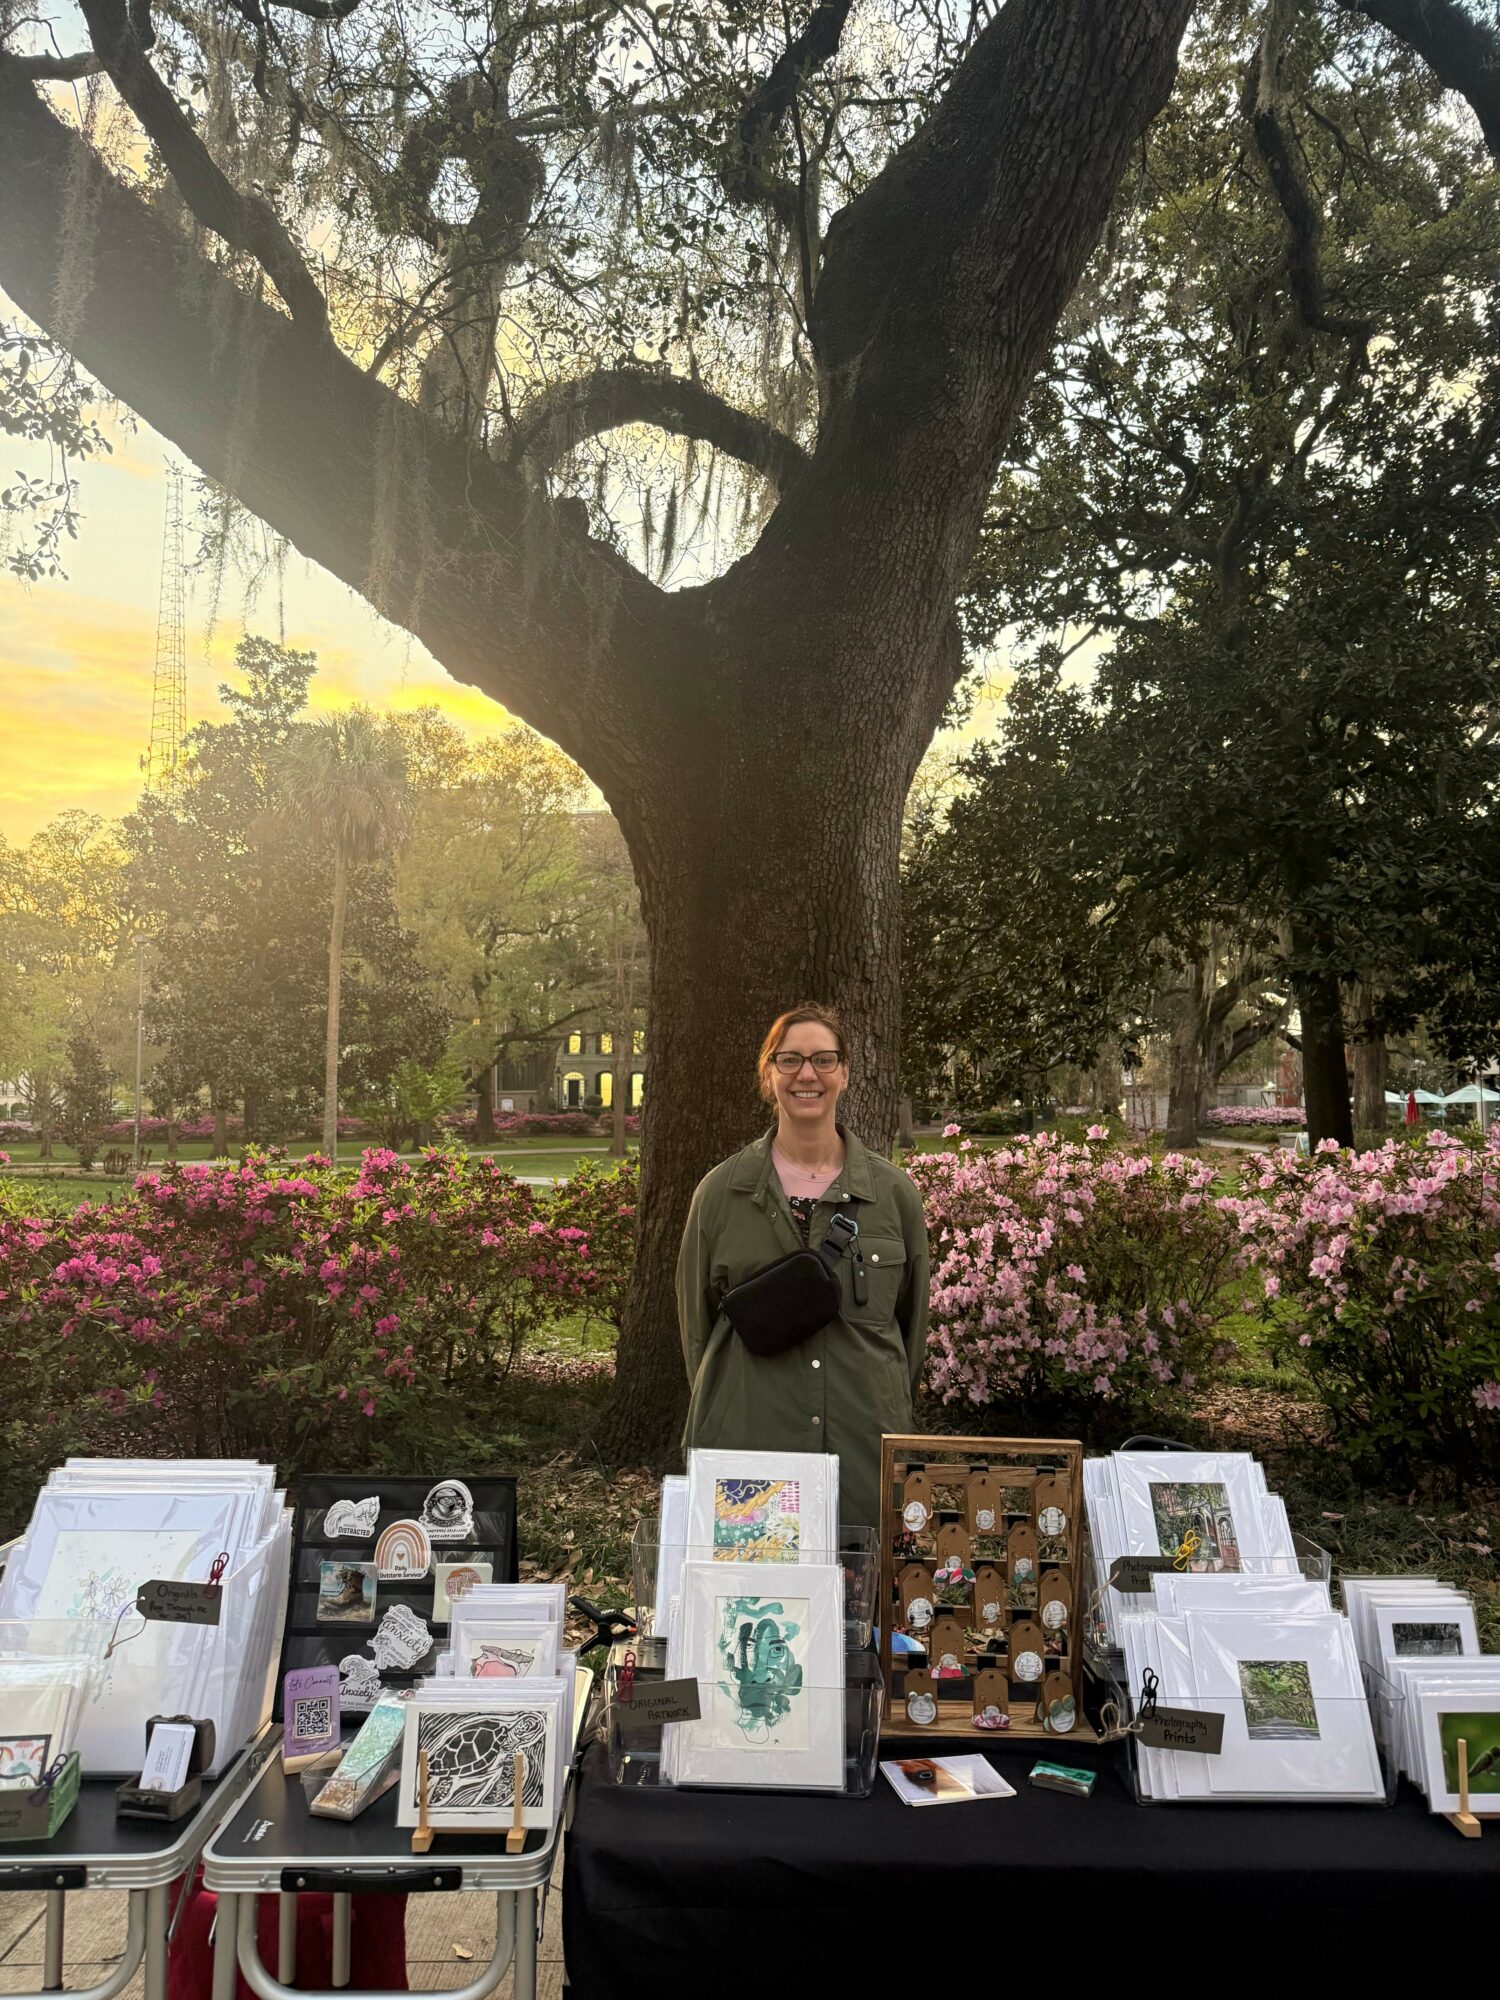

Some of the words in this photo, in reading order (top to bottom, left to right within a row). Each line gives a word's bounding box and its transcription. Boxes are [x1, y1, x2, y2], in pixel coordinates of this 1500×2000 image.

[394, 1565, 408, 1574] Daily
[1154, 1714, 1208, 1736] Photography
[1164, 1728, 1196, 1744] Prints
